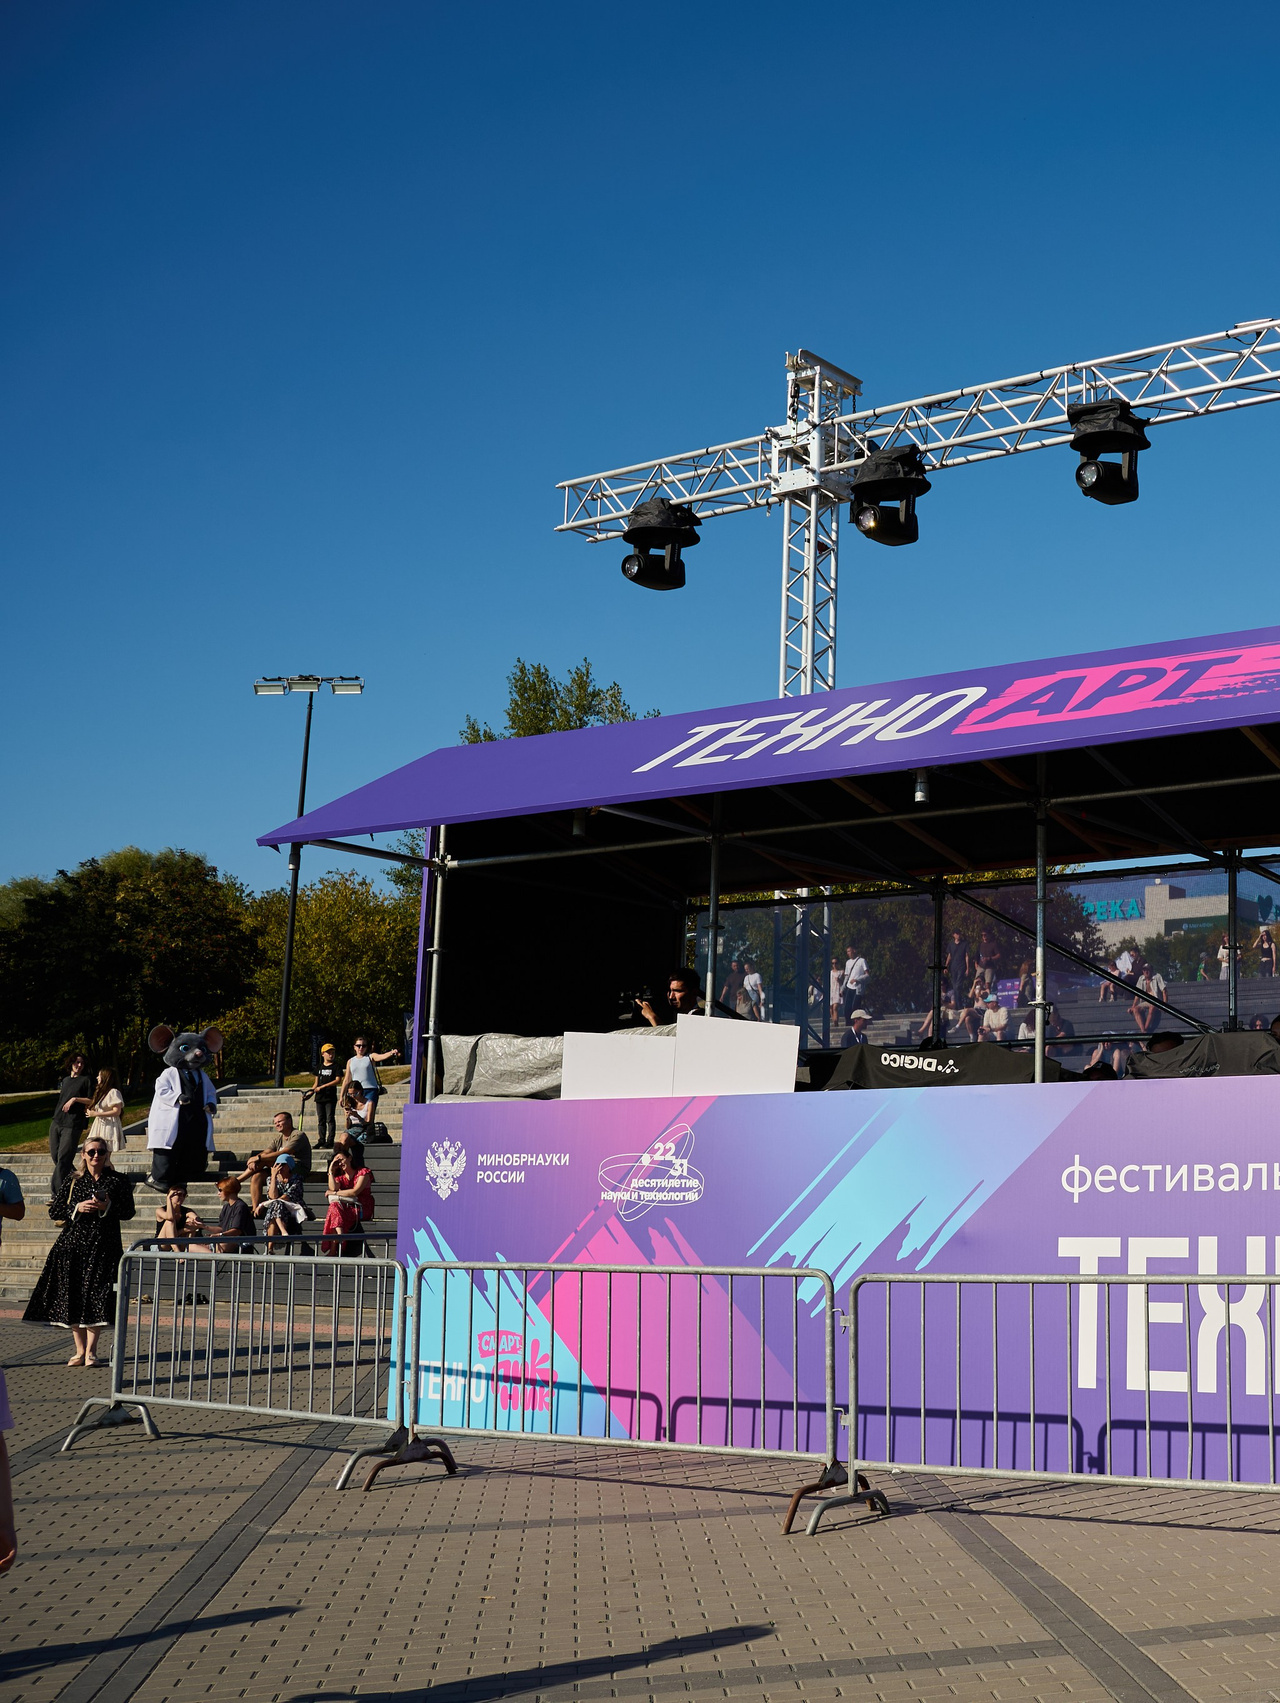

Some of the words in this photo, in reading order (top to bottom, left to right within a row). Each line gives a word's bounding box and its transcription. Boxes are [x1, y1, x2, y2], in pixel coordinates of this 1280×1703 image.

[632, 686, 988, 773] ТЕХНО
[970, 654, 1244, 725] АРТ
[1083, 897, 1141, 921] РЕКА
[653, 1142, 676, 1161] 22
[477, 1153, 570, 1167] МИНОБРНАУКИ
[476, 1171, 525, 1184] РОССИИ
[630, 1178, 699, 1189] десятилетие
[601, 1191, 630, 1203] науки
[631, 1191, 638, 1200] и
